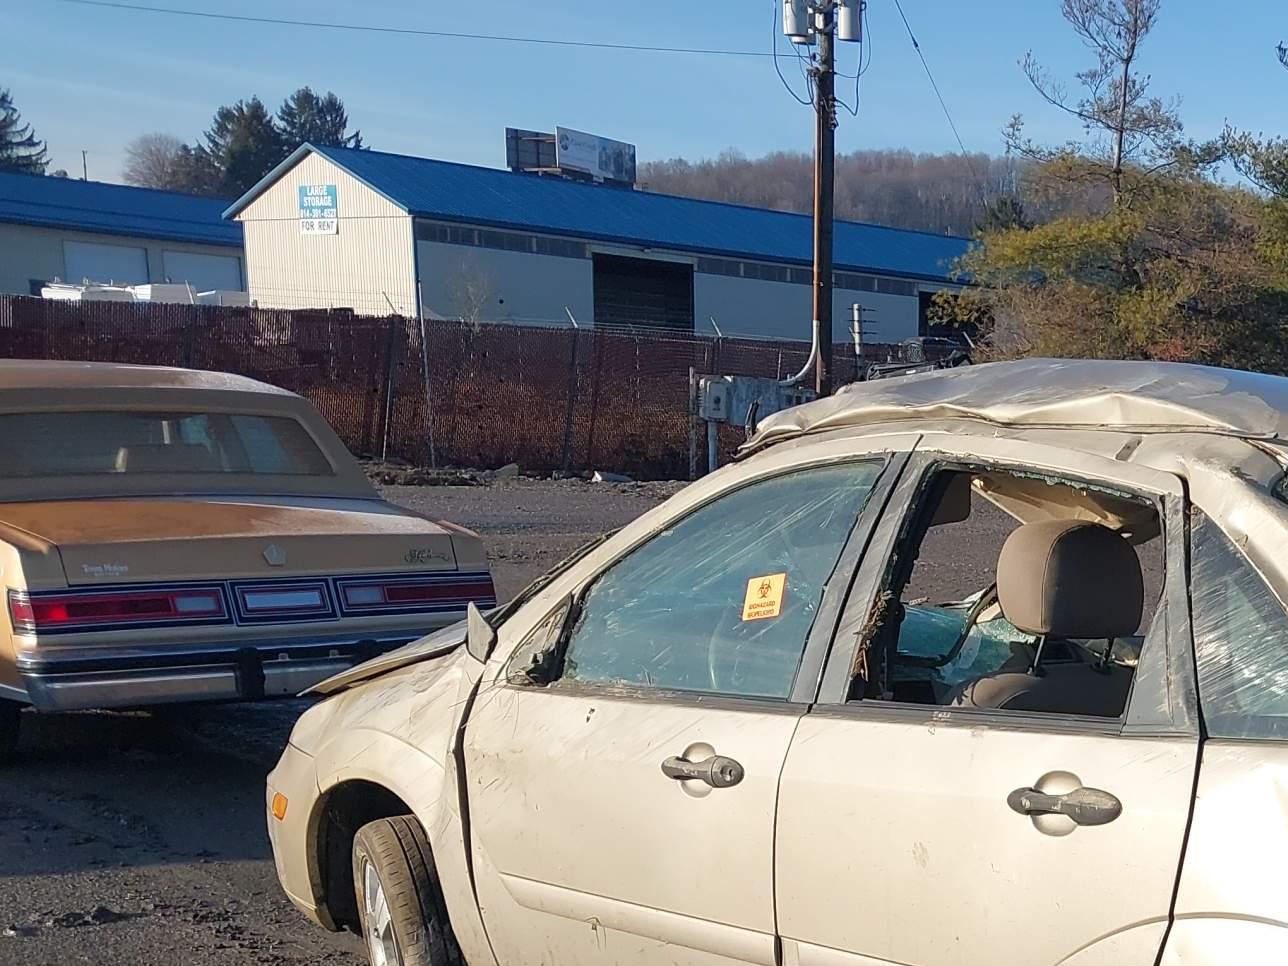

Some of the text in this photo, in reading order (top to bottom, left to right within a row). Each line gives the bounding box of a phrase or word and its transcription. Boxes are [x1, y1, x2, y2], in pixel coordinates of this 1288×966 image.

[307, 185, 328, 196] LARGE
[303, 195, 332, 207] STORAGE
[302, 220, 335, 231] FOR RENT
